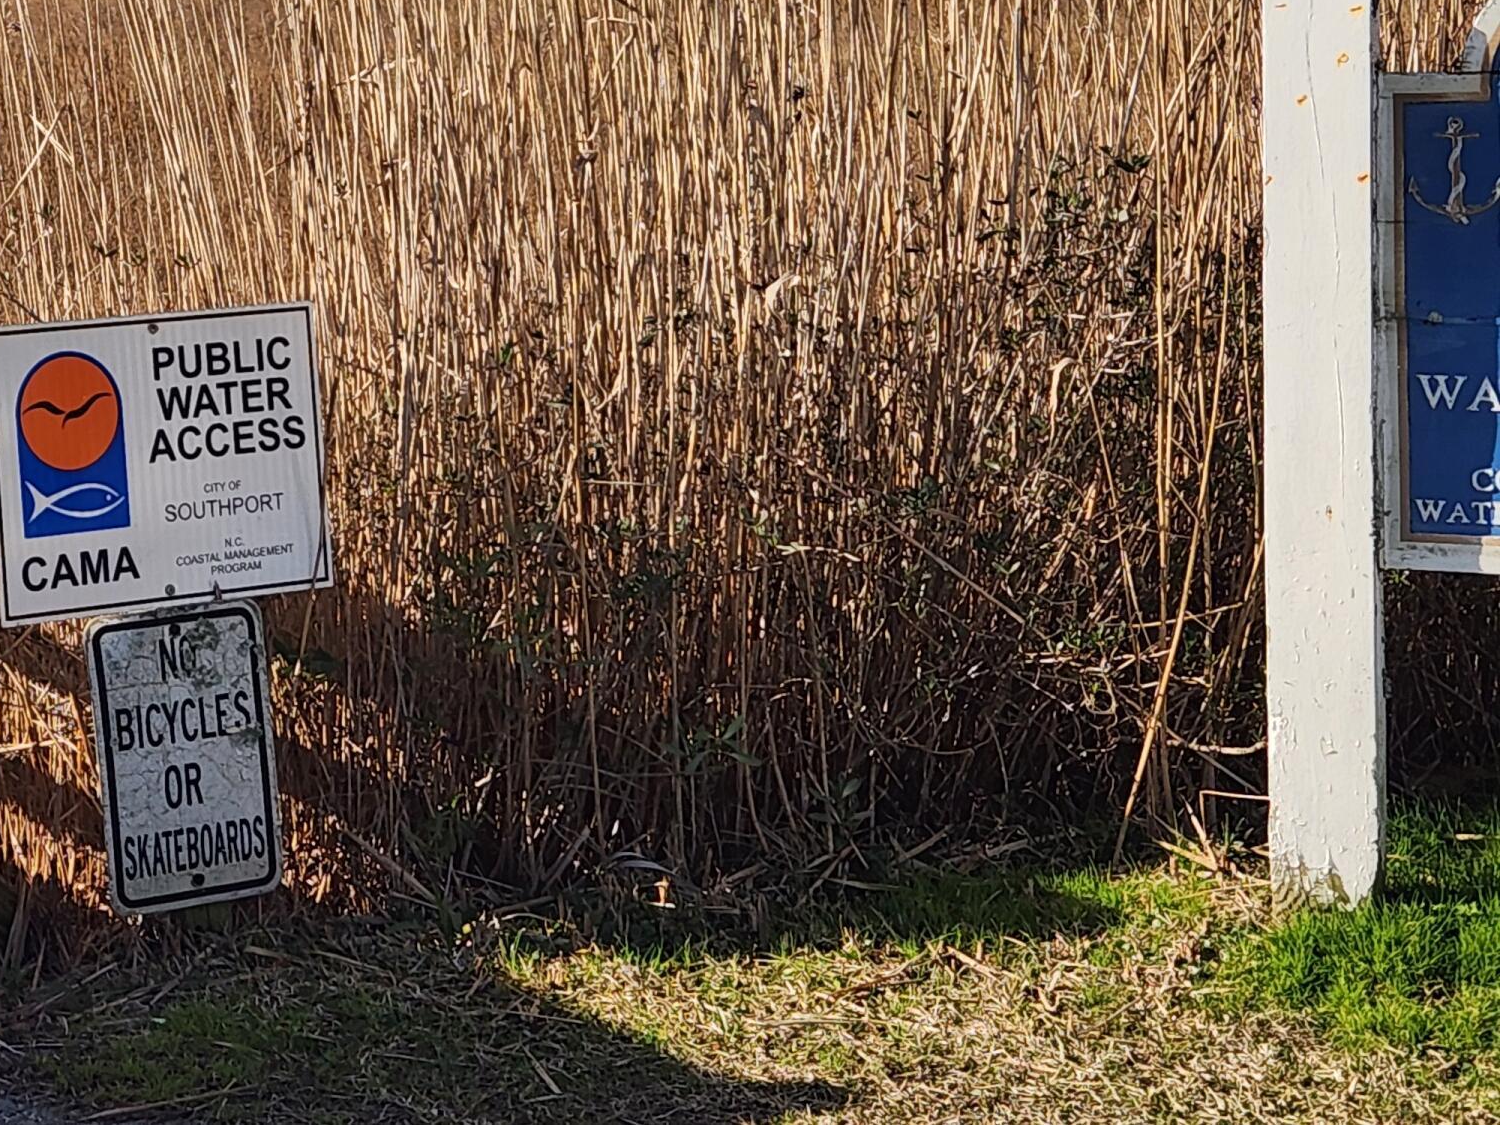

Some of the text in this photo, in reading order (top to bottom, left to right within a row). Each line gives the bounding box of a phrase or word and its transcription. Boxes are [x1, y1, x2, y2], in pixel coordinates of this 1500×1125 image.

[152, 336, 291, 380] PUBLIC
[156, 377, 292, 420] WATER
[149, 415, 306, 463] ACCESS
[203, 480, 241, 493] CITY OF
[1472, 468, 1500, 493] C
[164, 492, 284, 522] SOUTHPORT
[176, 543, 294, 566] COASTAL MANAGEMENT
[224, 537, 245, 548] N.C.
[21, 546, 140, 592] CAMA
[210, 560, 262, 575] PROGRAM
[115, 690, 251, 751] BICYCLES
[164, 763, 204, 809] OR
[124, 815, 265, 881] SKATEBOARDS
